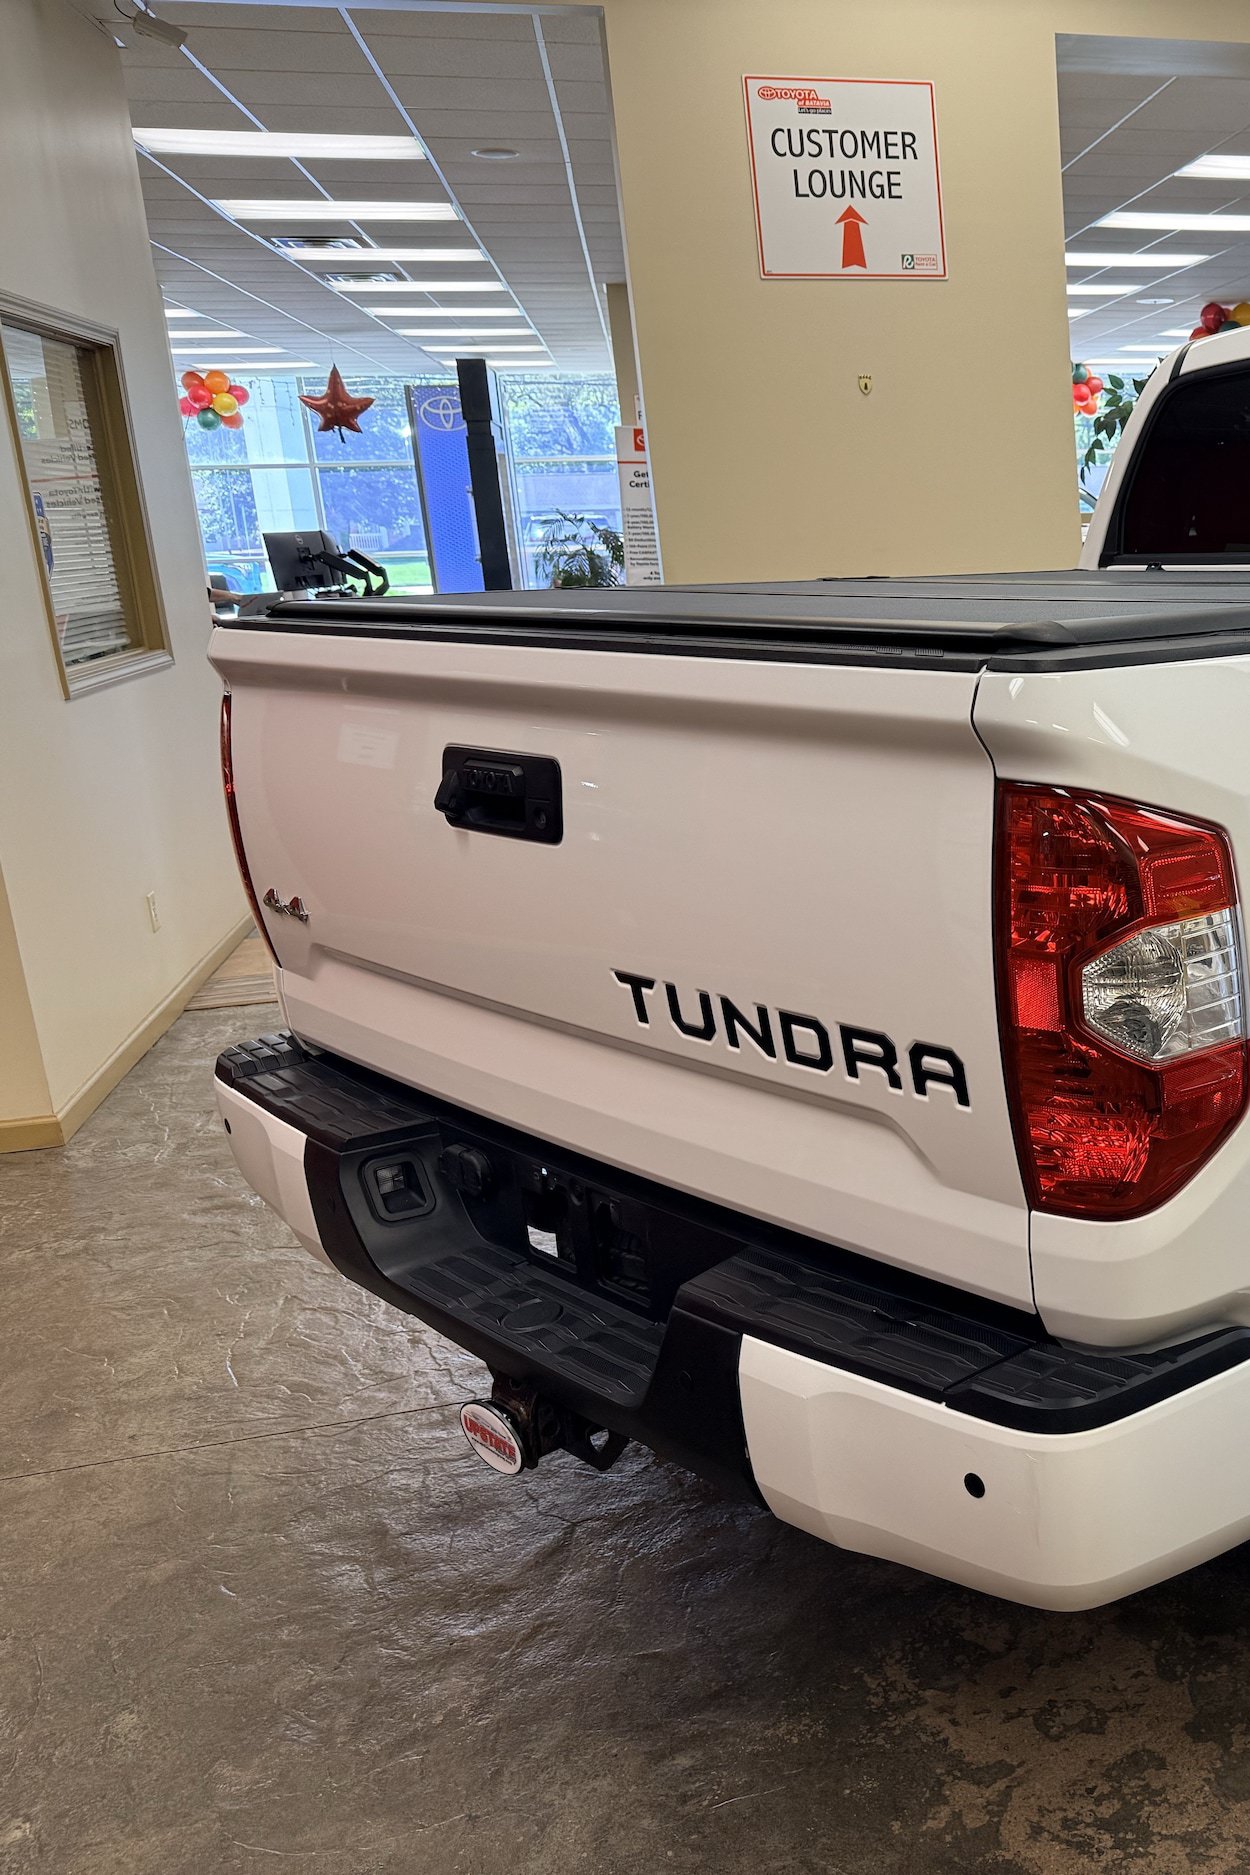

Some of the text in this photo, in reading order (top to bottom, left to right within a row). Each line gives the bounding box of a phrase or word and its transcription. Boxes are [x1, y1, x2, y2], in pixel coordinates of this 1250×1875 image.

[775, 89, 818, 100] TOYOTA
[771, 128, 918, 160] CUSTOMER
[793, 169, 902, 199] LOUNGE
[462, 768, 513, 794] TOYOTA
[610, 968, 972, 1112] TUNDRA
[463, 1413, 517, 1466] UPSTATE
